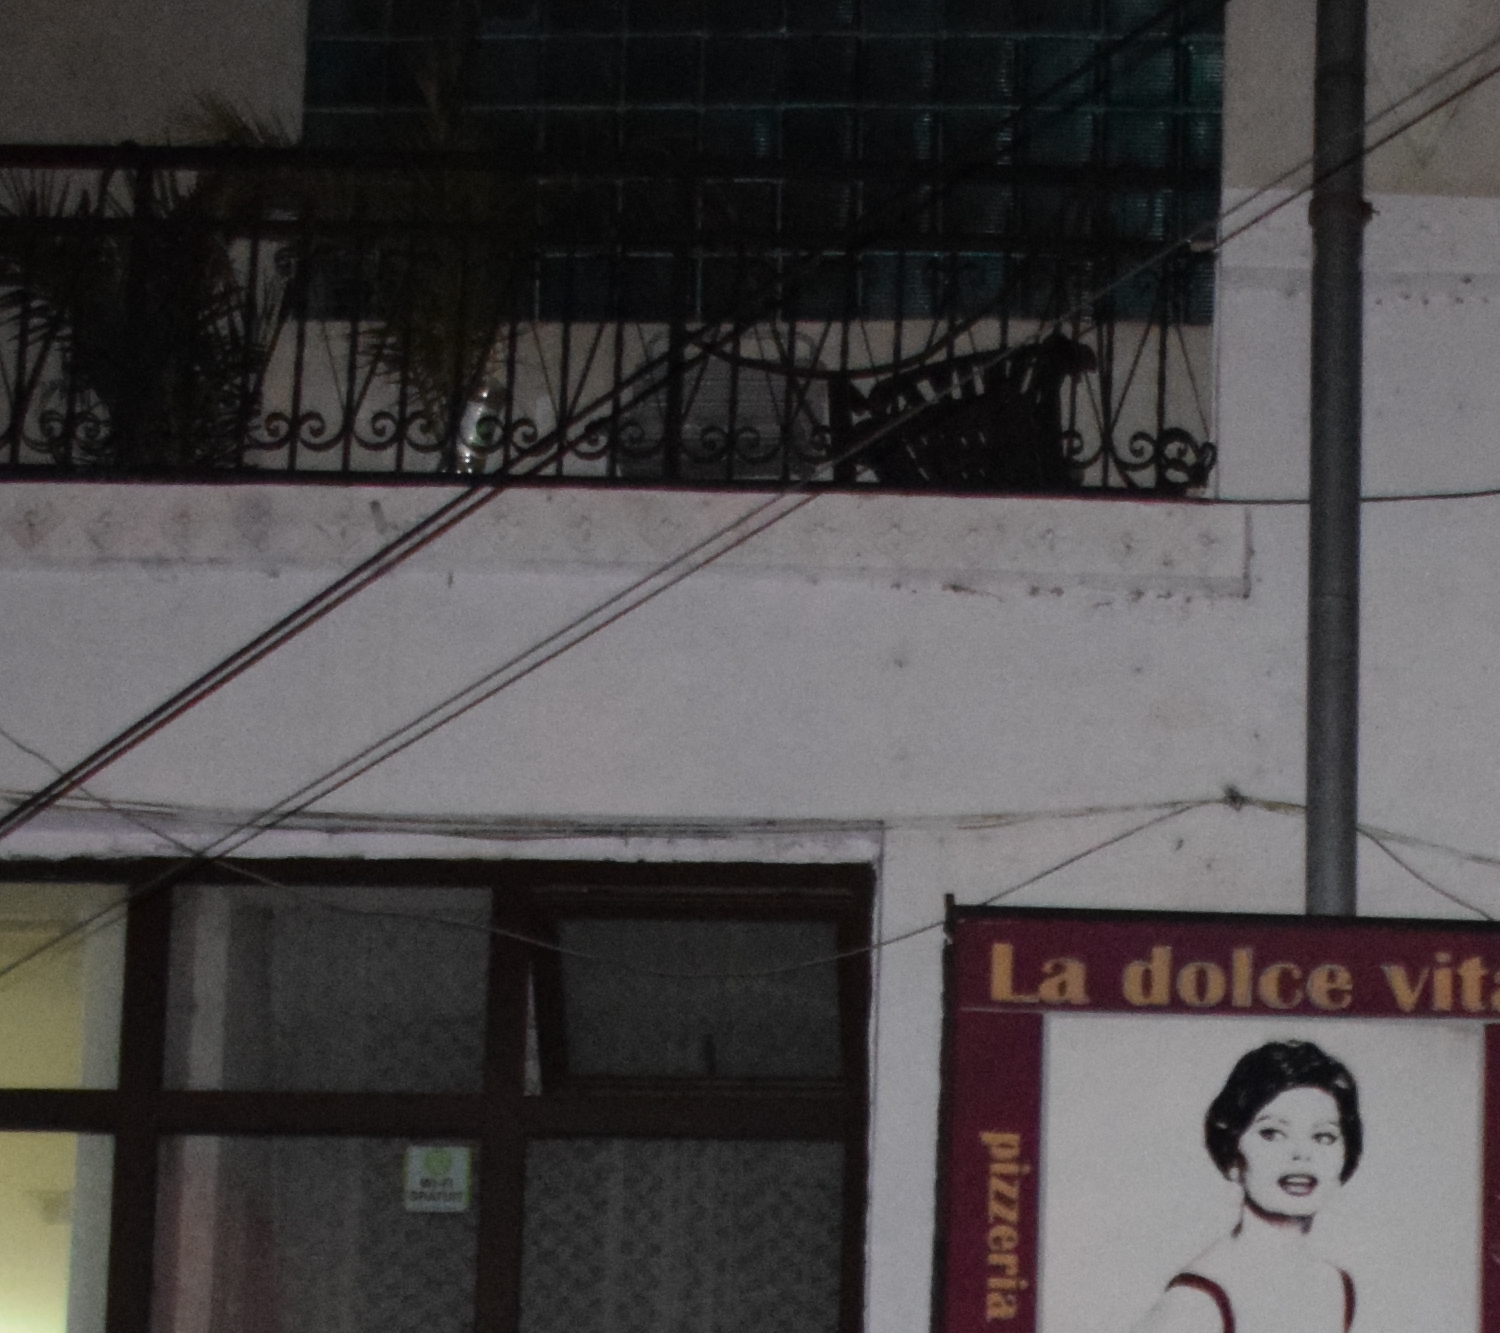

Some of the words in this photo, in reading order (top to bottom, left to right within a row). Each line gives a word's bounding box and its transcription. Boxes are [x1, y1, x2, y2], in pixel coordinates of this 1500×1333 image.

[987, 942, 1090, 1004] La
[1121, 946, 1354, 1011] dolce
[979, 1130, 1031, 1323] pizzeria
